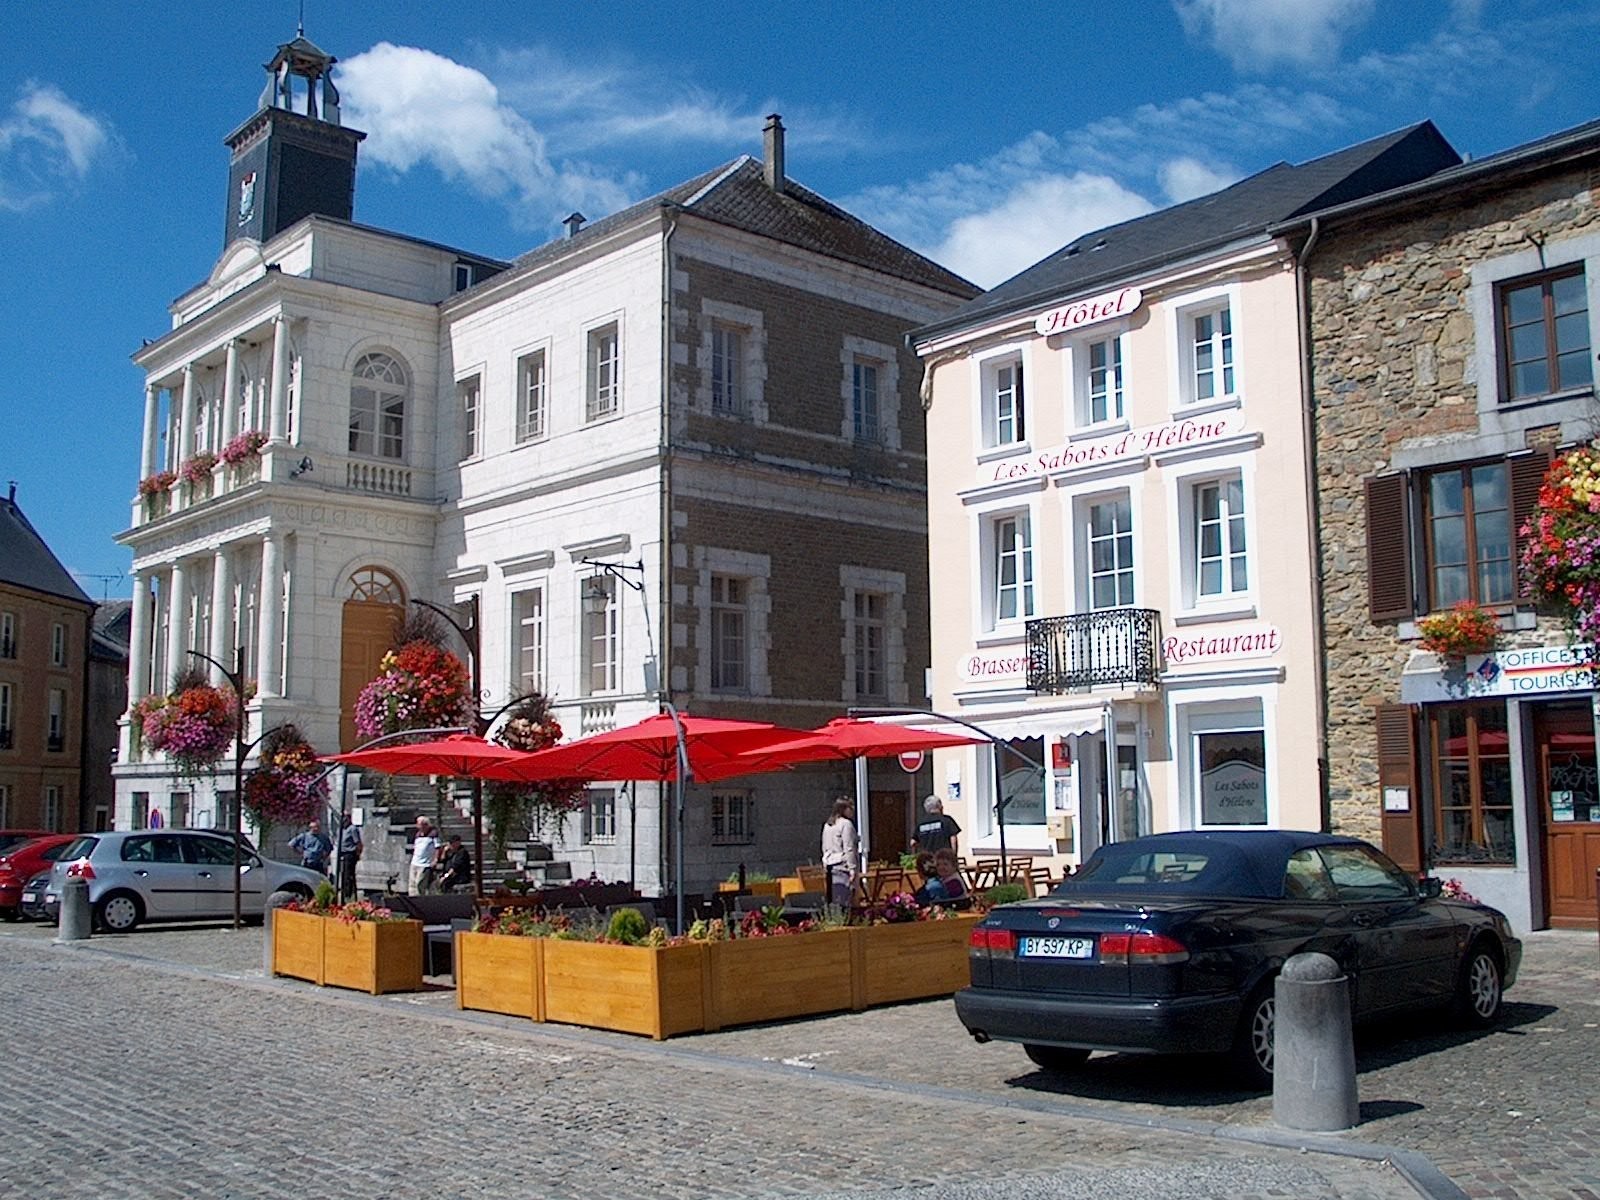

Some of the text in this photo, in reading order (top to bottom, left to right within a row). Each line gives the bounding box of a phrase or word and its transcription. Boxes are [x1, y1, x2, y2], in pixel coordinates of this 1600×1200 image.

[1045, 288, 1131, 332] Hôtel
[994, 462, 1029, 480] Les
[1034, 444, 1108, 472] Sabots
[1164, 629, 1277, 662] Restaurant
[1507, 650, 1571, 666] OFFICE
[968, 655, 1042, 676] Brasser
